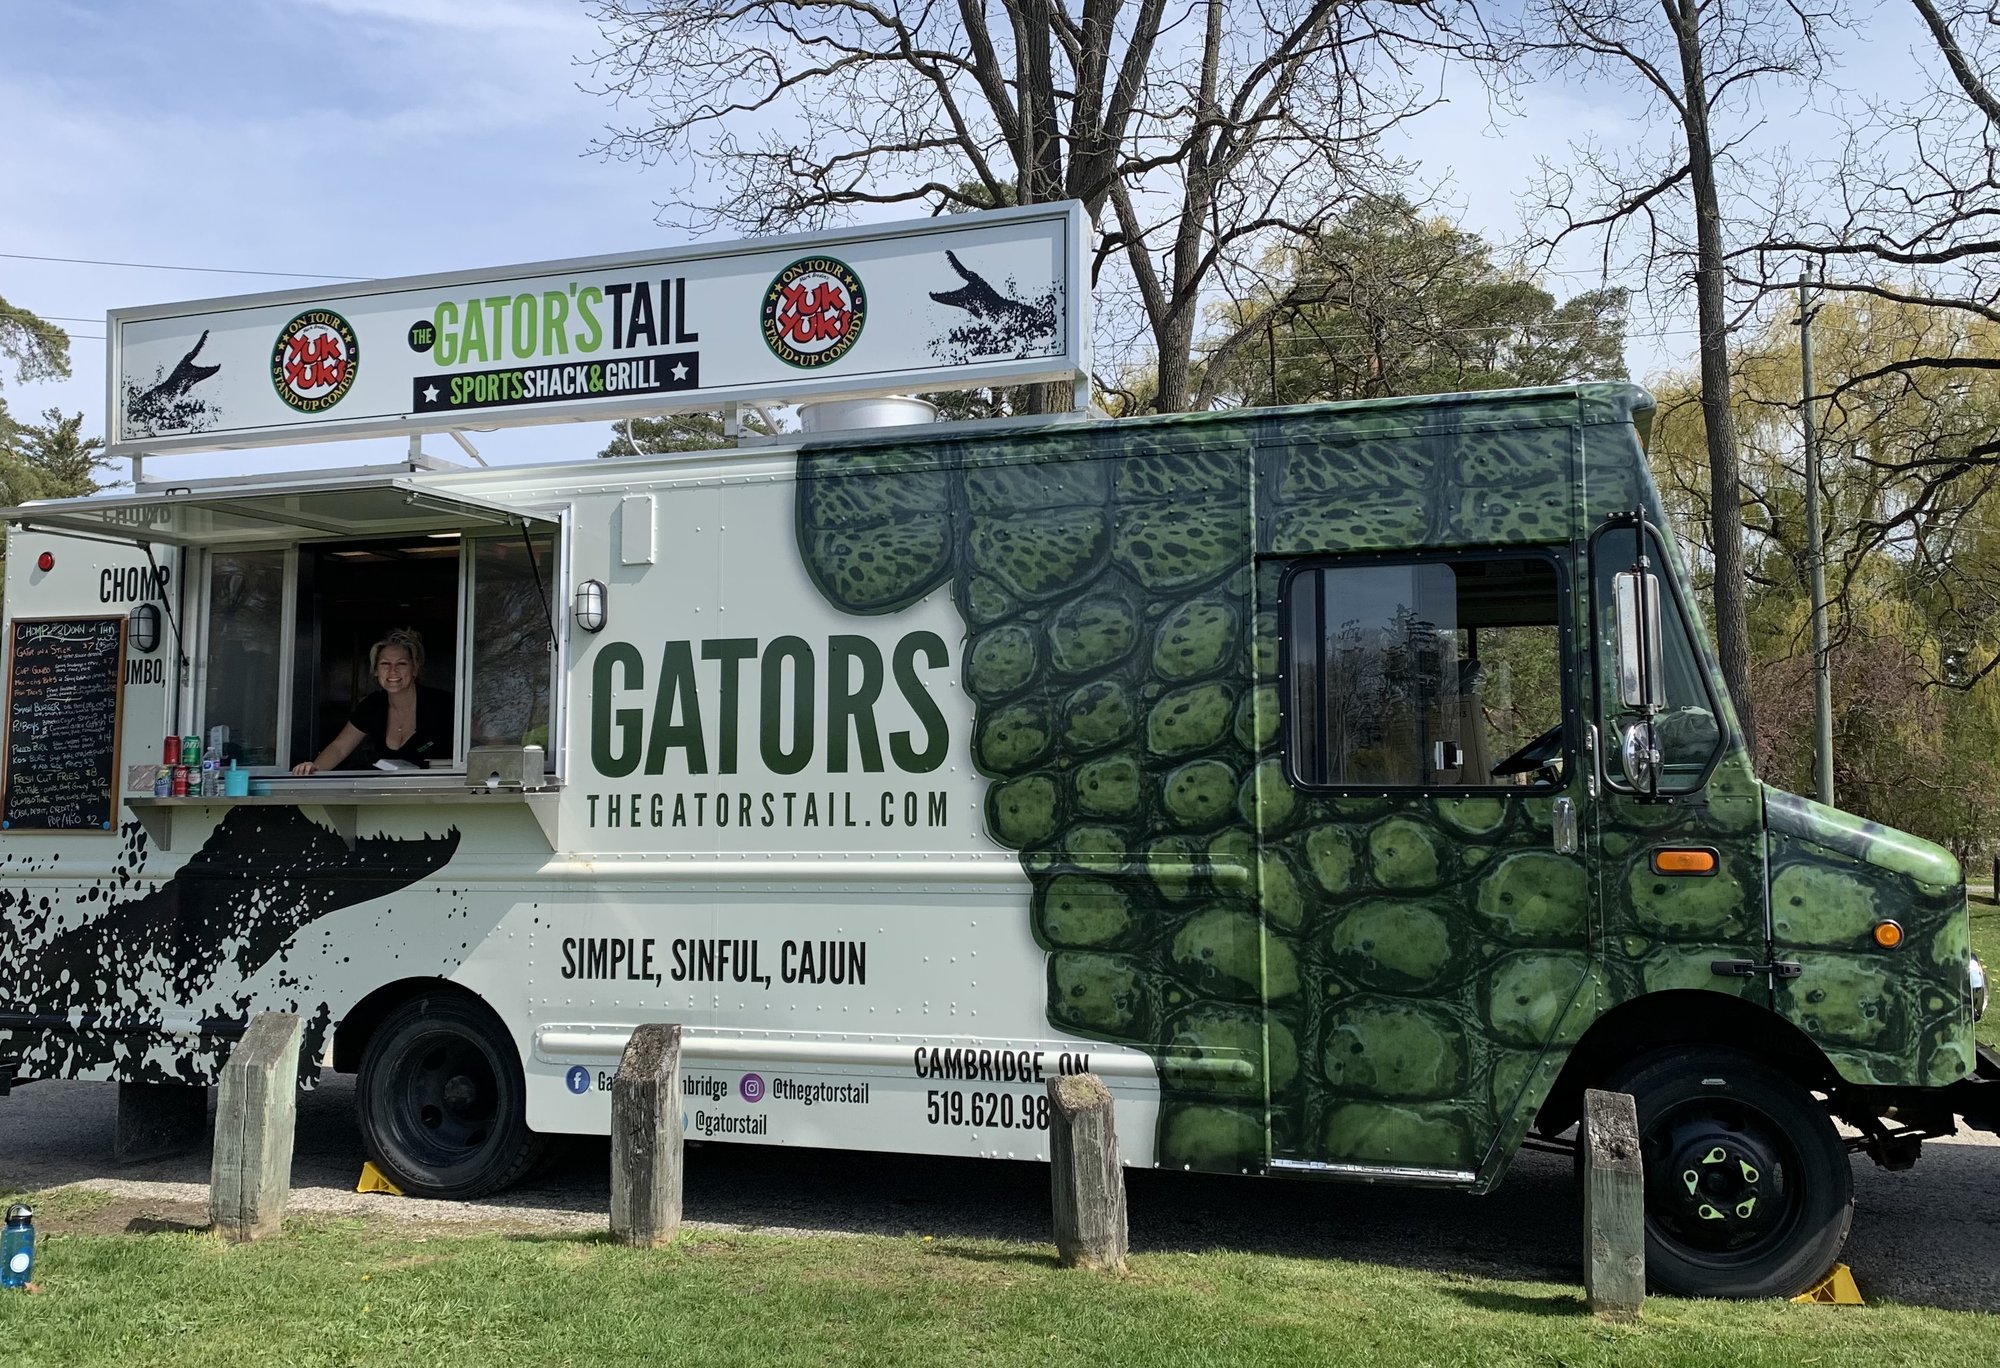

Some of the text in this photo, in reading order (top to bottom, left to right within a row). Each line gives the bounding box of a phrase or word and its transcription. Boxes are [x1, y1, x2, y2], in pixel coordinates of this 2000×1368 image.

[782, 260, 844, 283] ON TOUR
[289, 312, 340, 333] ON TOUR
[412, 277, 699, 367] THE GATOR'S TAIL
[821, 309, 864, 362] COMEDY
[320, 359, 357, 407] COMEDY
[100, 565, 170, 603] CHOMP
[124, 658, 166, 688] UMBO,
[34, 702, 60, 712] BURGER
[590, 630, 950, 778] GATORS
[13, 773, 33, 785] FRESH
[57, 771, 81, 781] FRIES
[85, 767, 97, 777] $8
[87, 814, 100, 826] $2
[586, 791, 948, 828] THEGATORSTAIL.COM
[561, 937, 866, 990] SIMPLE, SINFUL, CAJUN
[914, 1046, 1045, 1084] CAMBRIDGE
[682, 1074, 728, 1098] bridge
[772, 1076, 869, 1105] @thegatorstail
[695, 1110, 767, 1135] @gatorstail
[926, 1090, 1050, 1131] 519.620.98
